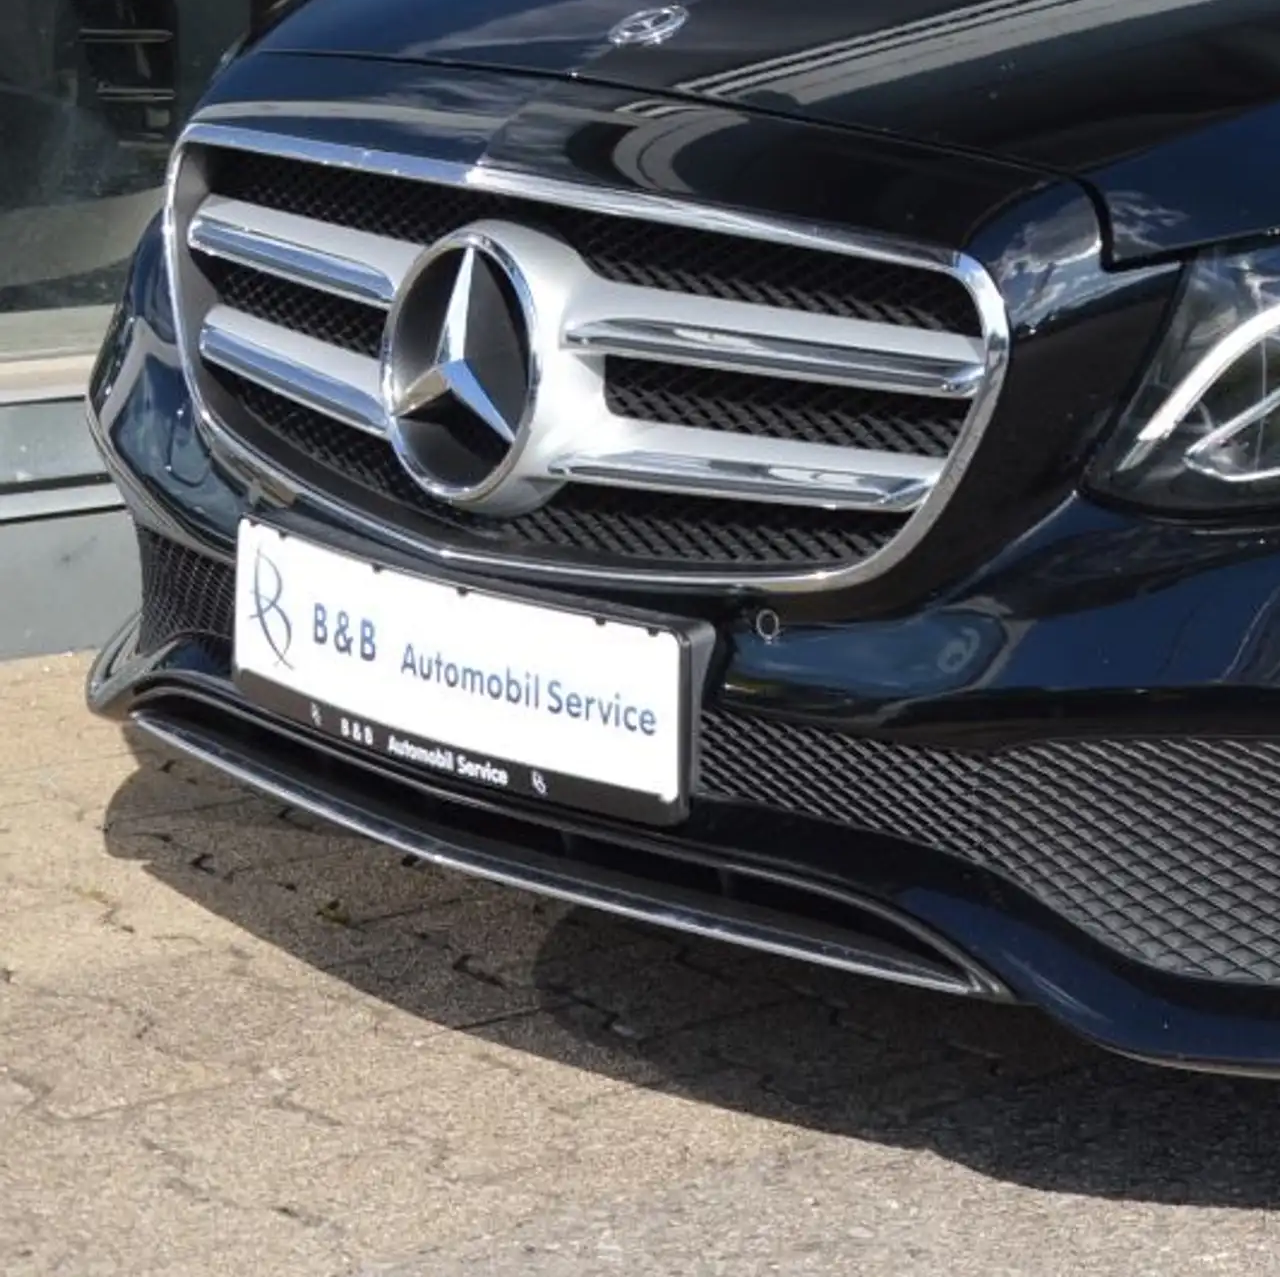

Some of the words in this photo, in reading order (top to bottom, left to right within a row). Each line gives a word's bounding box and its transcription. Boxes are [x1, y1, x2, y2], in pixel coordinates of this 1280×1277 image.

[401, 642, 541, 710] Automobil
[547, 679, 657, 736] Service
[387, 734, 455, 772] Automobil
[456, 754, 509, 787] Service
